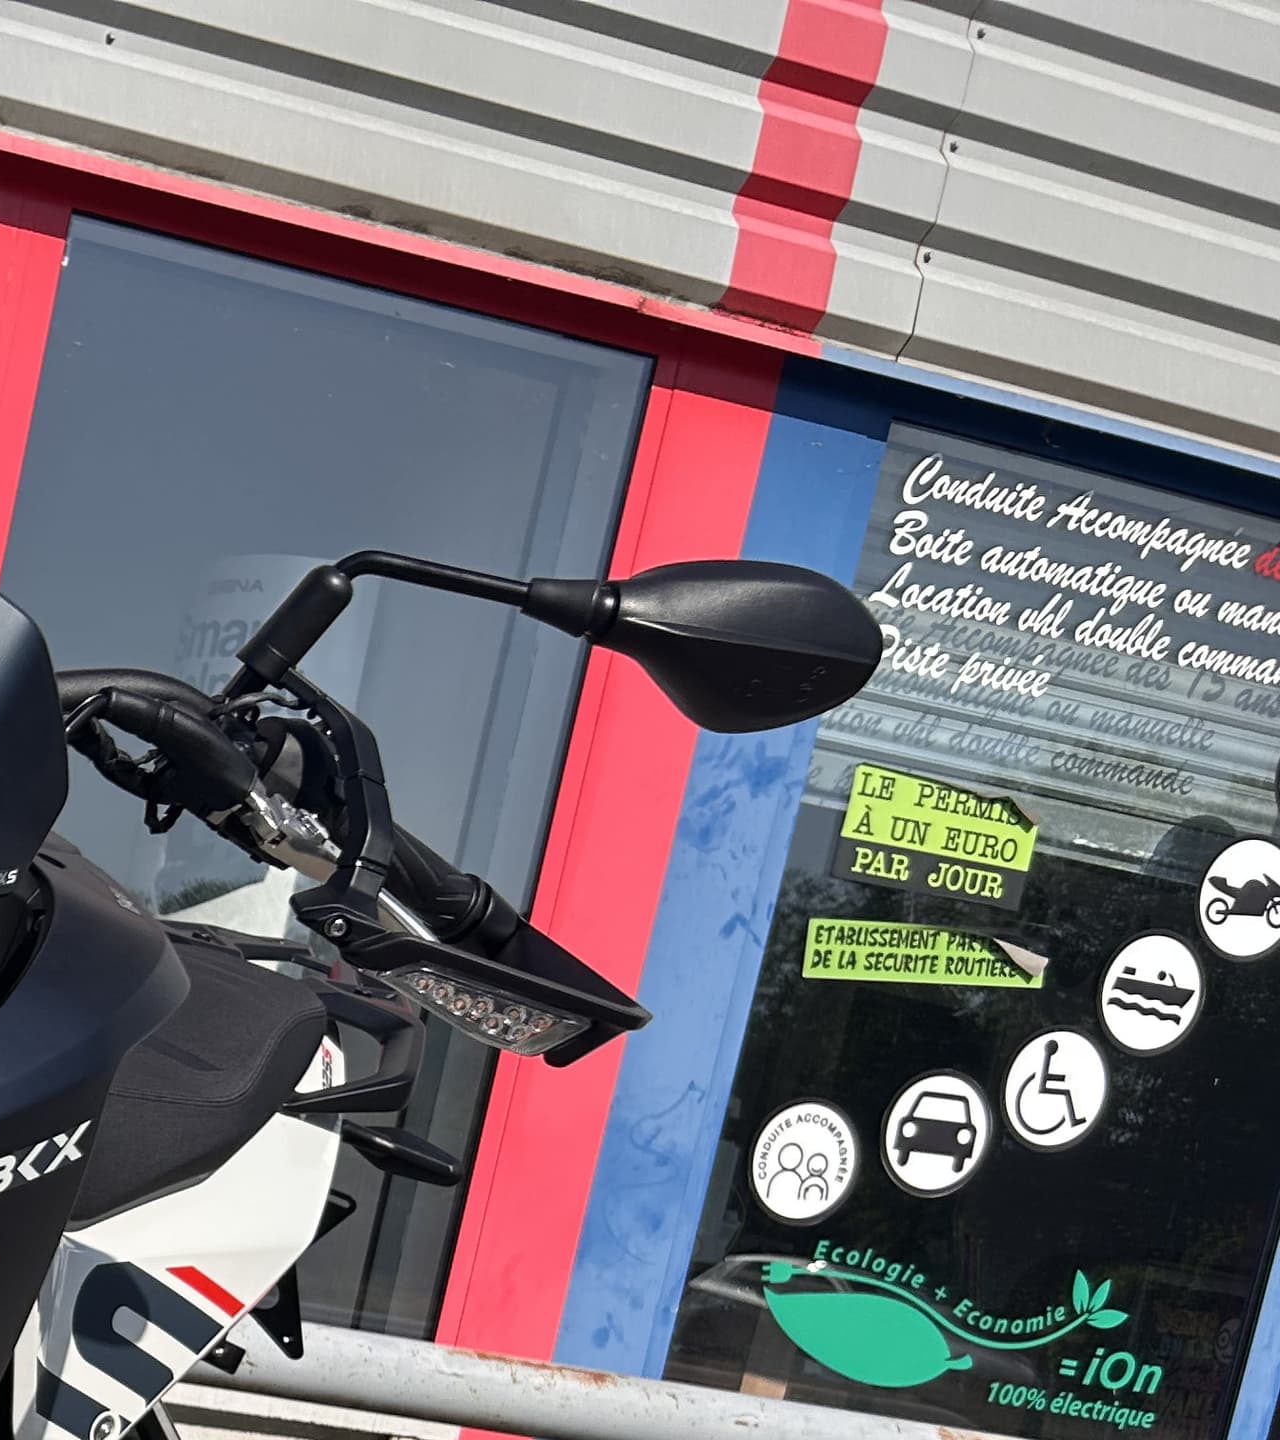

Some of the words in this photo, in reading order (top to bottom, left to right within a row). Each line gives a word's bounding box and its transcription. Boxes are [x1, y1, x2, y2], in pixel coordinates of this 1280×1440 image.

[903, 453, 1046, 521] Conduite
[890, 510, 974, 566] Boite
[981, 546, 1167, 616] automatique
[1174, 589, 1212, 617] ou
[868, 562, 1011, 626] Location
[1018, 593, 1074, 639] vhl
[1074, 607, 1171, 661] double
[951, 652, 1051, 697] privée
[857, 771, 896, 801] LE
[852, 804, 874, 836] À
[891, 816, 931, 846] UN
[941, 826, 1018, 863] EURO
[851, 847, 910, 881] PAR
[927, 862, 1003, 899] JOUR
[811, 949, 832, 969] DE
[838, 950, 856, 970] LA
[864, 951, 939, 974] SECURITE
[814, 924, 941, 950] ETABLISSEMENT
[757, 1117, 794, 1180] CONDUITE
[813, 1240, 927, 1288] Ecologie
[952, 1299, 1066, 1335] Economie
[1082, 1347, 1163, 1394] iOn
[988, 1381, 1047, 1410] 100%
[1049, 1391, 1156, 1430] électrique
